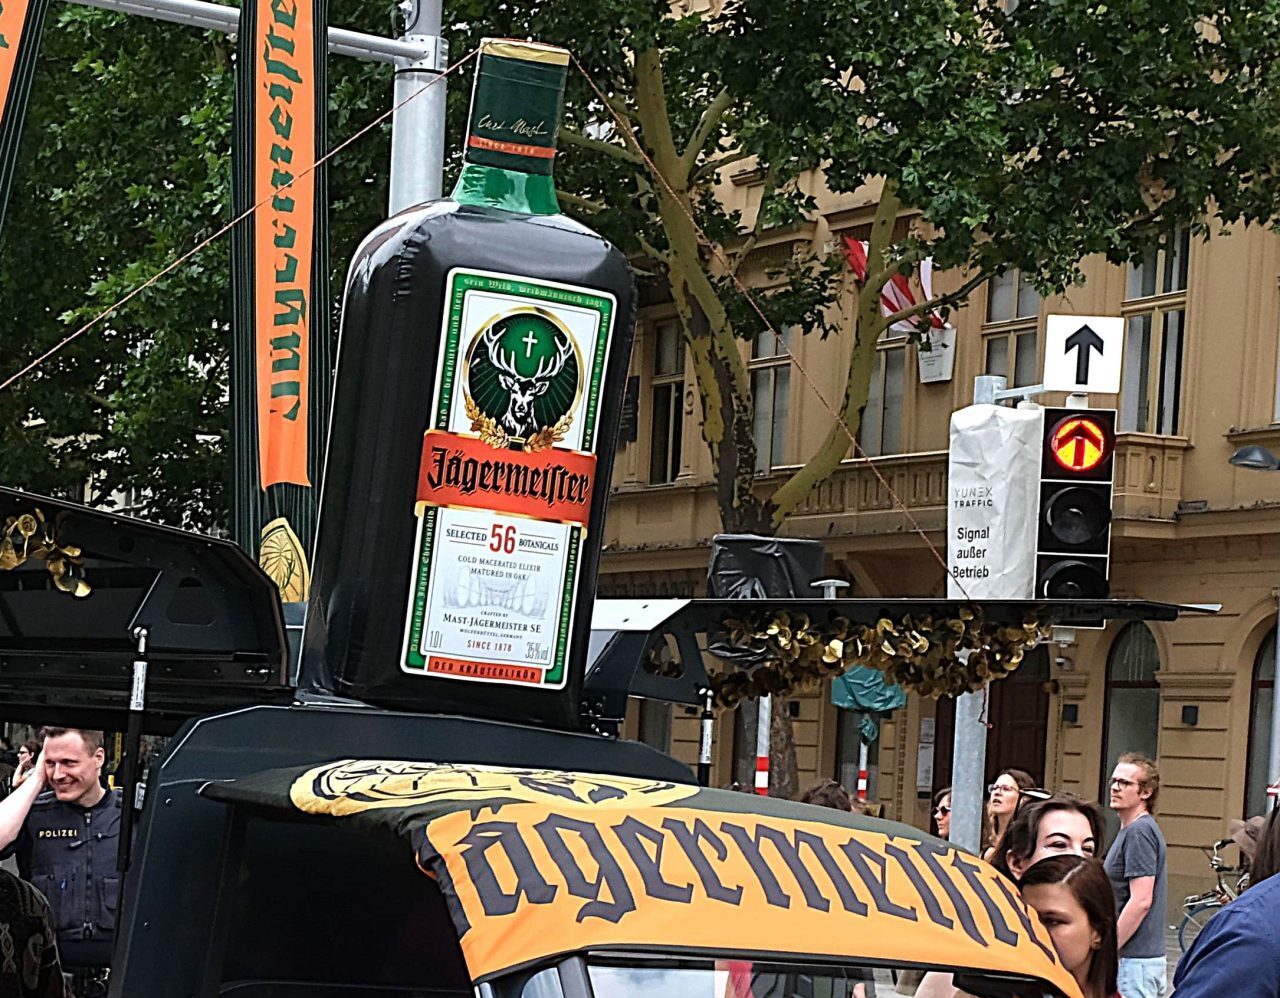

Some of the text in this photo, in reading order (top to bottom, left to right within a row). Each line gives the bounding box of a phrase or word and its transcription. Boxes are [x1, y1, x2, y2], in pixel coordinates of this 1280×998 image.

[426, 446, 591, 508] Jägermeister
[954, 486, 993, 498] YUNEX
[954, 499, 993, 508] TRAFFIC
[446, 523, 559, 554] SELECTED 56 BOTANICALS
[957, 526, 990, 543] Signal
[956, 546, 987, 559] außer
[457, 555, 541, 573] COLD MACERATED ELIXIR
[470, 567, 504, 578] MATURED
[505, 571, 512, 580] IN
[952, 565, 989, 578] Betrieb
[530, 623, 542, 634] SE
[467, 639, 512, 652] SINCE 1878
[434, 660, 537, 681] DER KRÄUTERLIKÖR
[39, 829, 78, 838] POLIZEI
